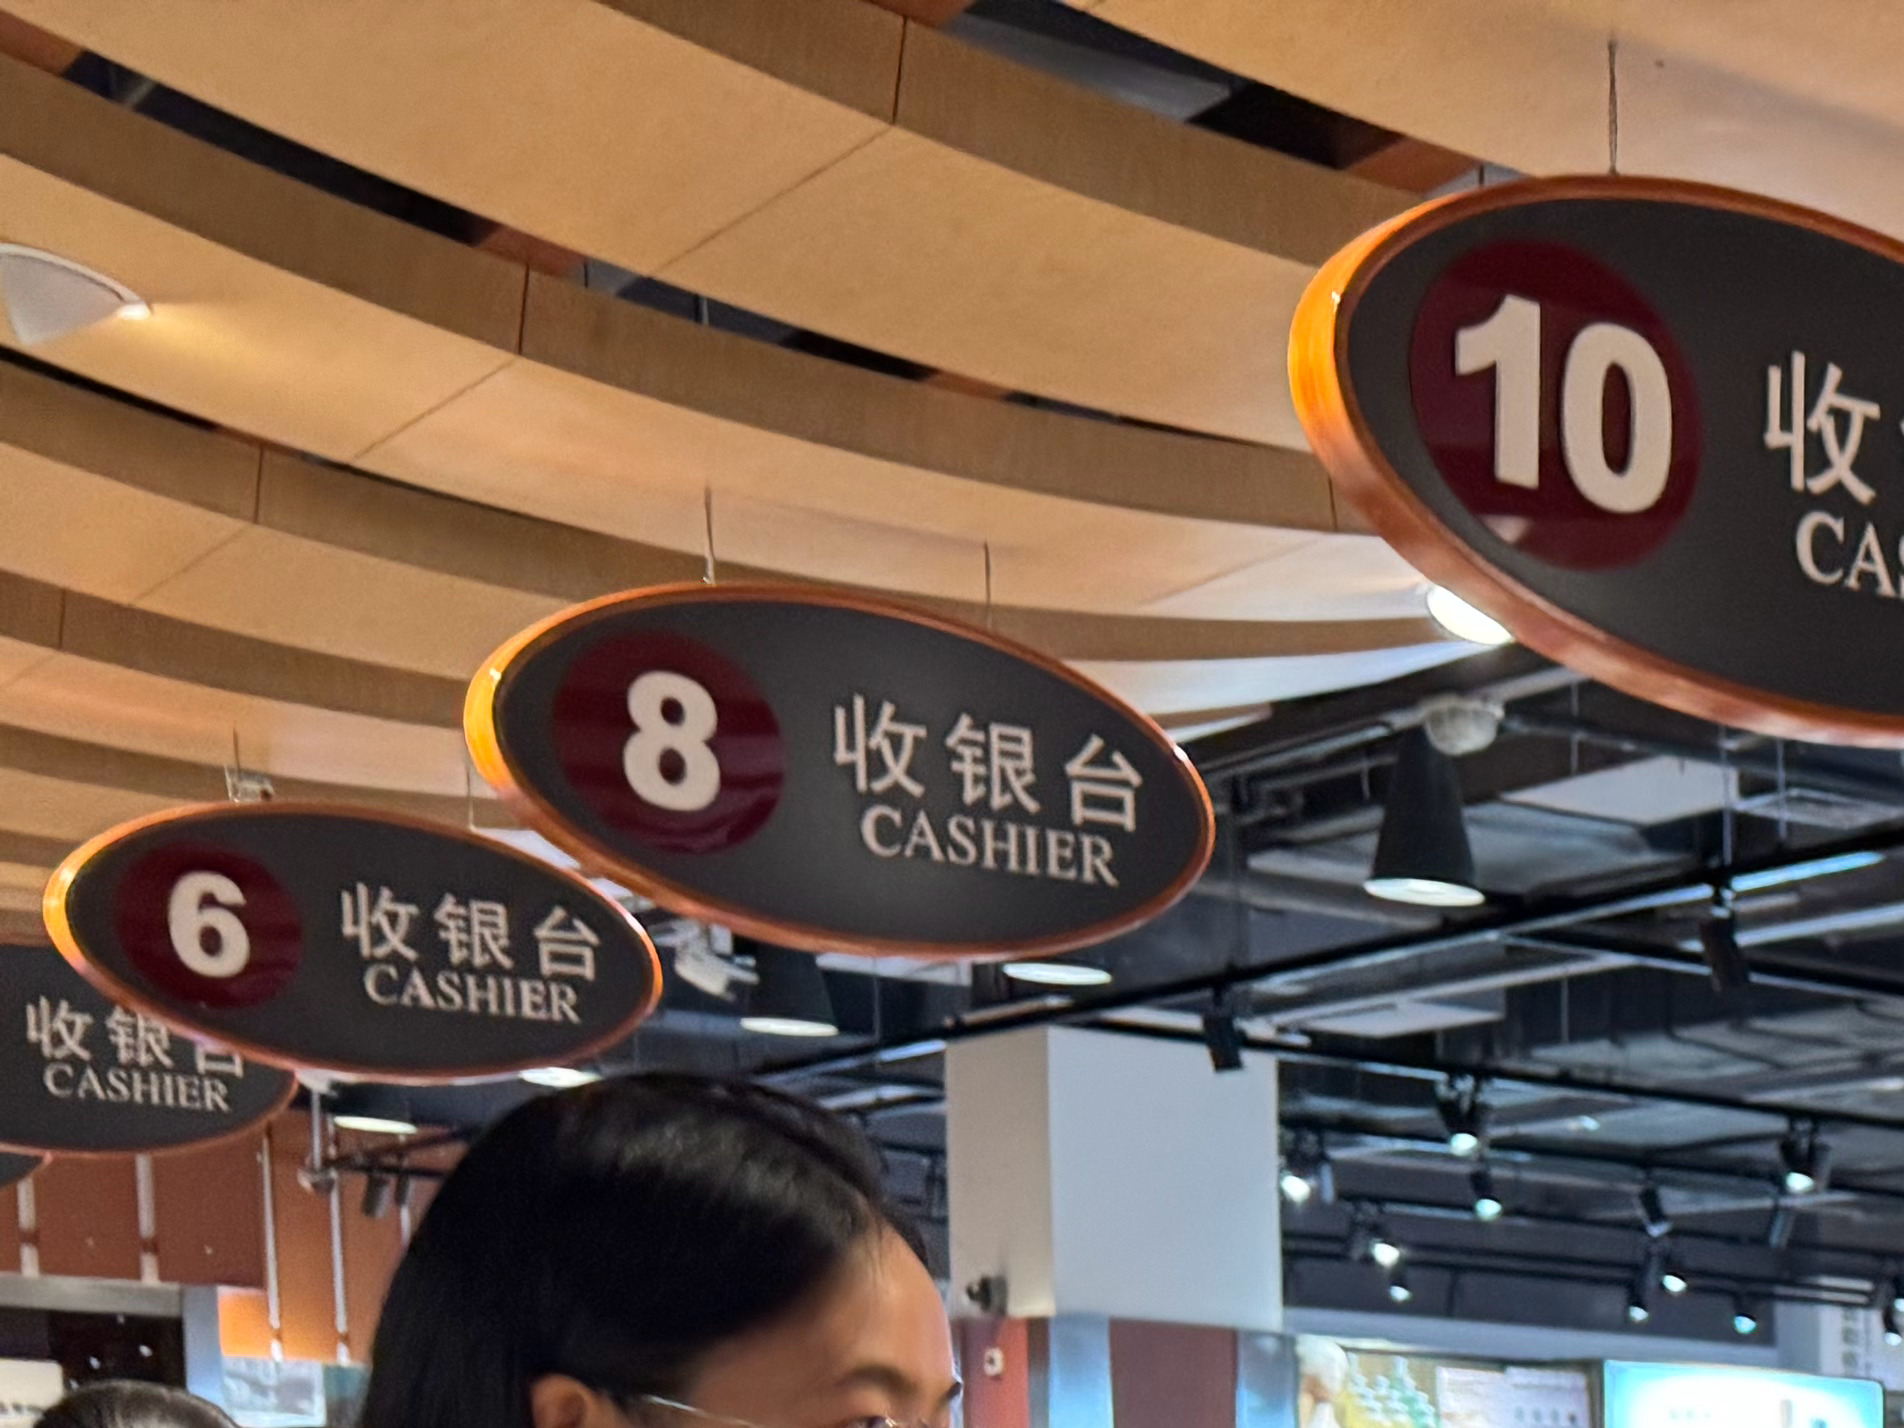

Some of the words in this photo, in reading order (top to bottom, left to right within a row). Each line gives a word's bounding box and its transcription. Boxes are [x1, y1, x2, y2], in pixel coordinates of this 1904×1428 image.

[1456, 293, 1672, 512] 10
[624, 671, 721, 812] 8
[833, 694, 1142, 831] 收银台
[860, 804, 1118, 886] CASHIER
[168, 871, 250, 978] 6
[341, 881, 600, 980] 收银台
[363, 964, 581, 1024] CASHIER
[43, 1061, 232, 1113] CASHIER
